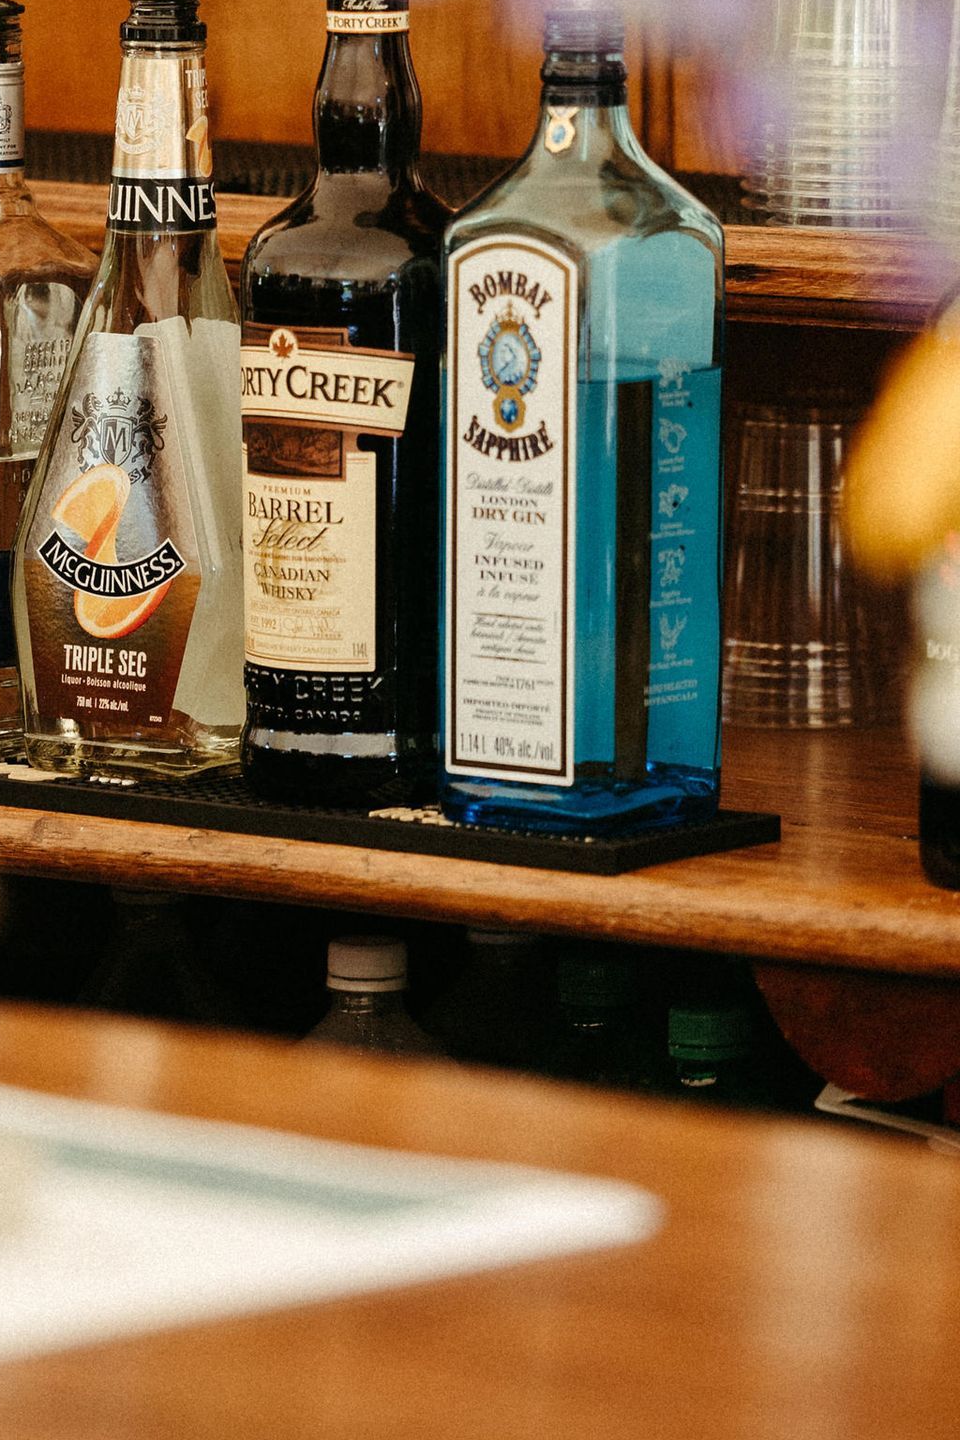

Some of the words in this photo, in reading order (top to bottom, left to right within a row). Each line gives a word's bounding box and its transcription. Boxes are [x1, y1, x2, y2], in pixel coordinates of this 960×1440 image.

[333, 17, 365, 28] FORTY
[366, 16, 399, 28] CREEK
[469, 271, 553, 320] BOMBAY
[286, 365, 395, 409] CREEK
[463, 415, 554, 462] SAPPHIRE
[263, 485, 311, 495] PREMIUM
[248, 491, 344, 525] BARREL
[481, 495, 538, 507] LONDON
[472, 506, 508, 521] DRY
[511, 510, 546, 524] GIN
[252, 517, 329, 551] Select
[254, 562, 330, 582] CANADIAN
[474, 554, 544, 571] INFUSED
[260, 582, 316, 601] WHISKY
[261, 618, 277, 630] 1992
[63, 644, 114, 674] TRIPLE
[118, 649, 147, 678] SEC
[61, 673, 82, 685] Liquor
[86, 676, 111, 689] Boisson
[113, 679, 146, 692] alcoolique
[99, 698, 109, 710] 22%
[460, 732, 480, 754] 1.14
[495, 737, 515, 758] 40%
[517, 740, 557, 763] alc./vol.
